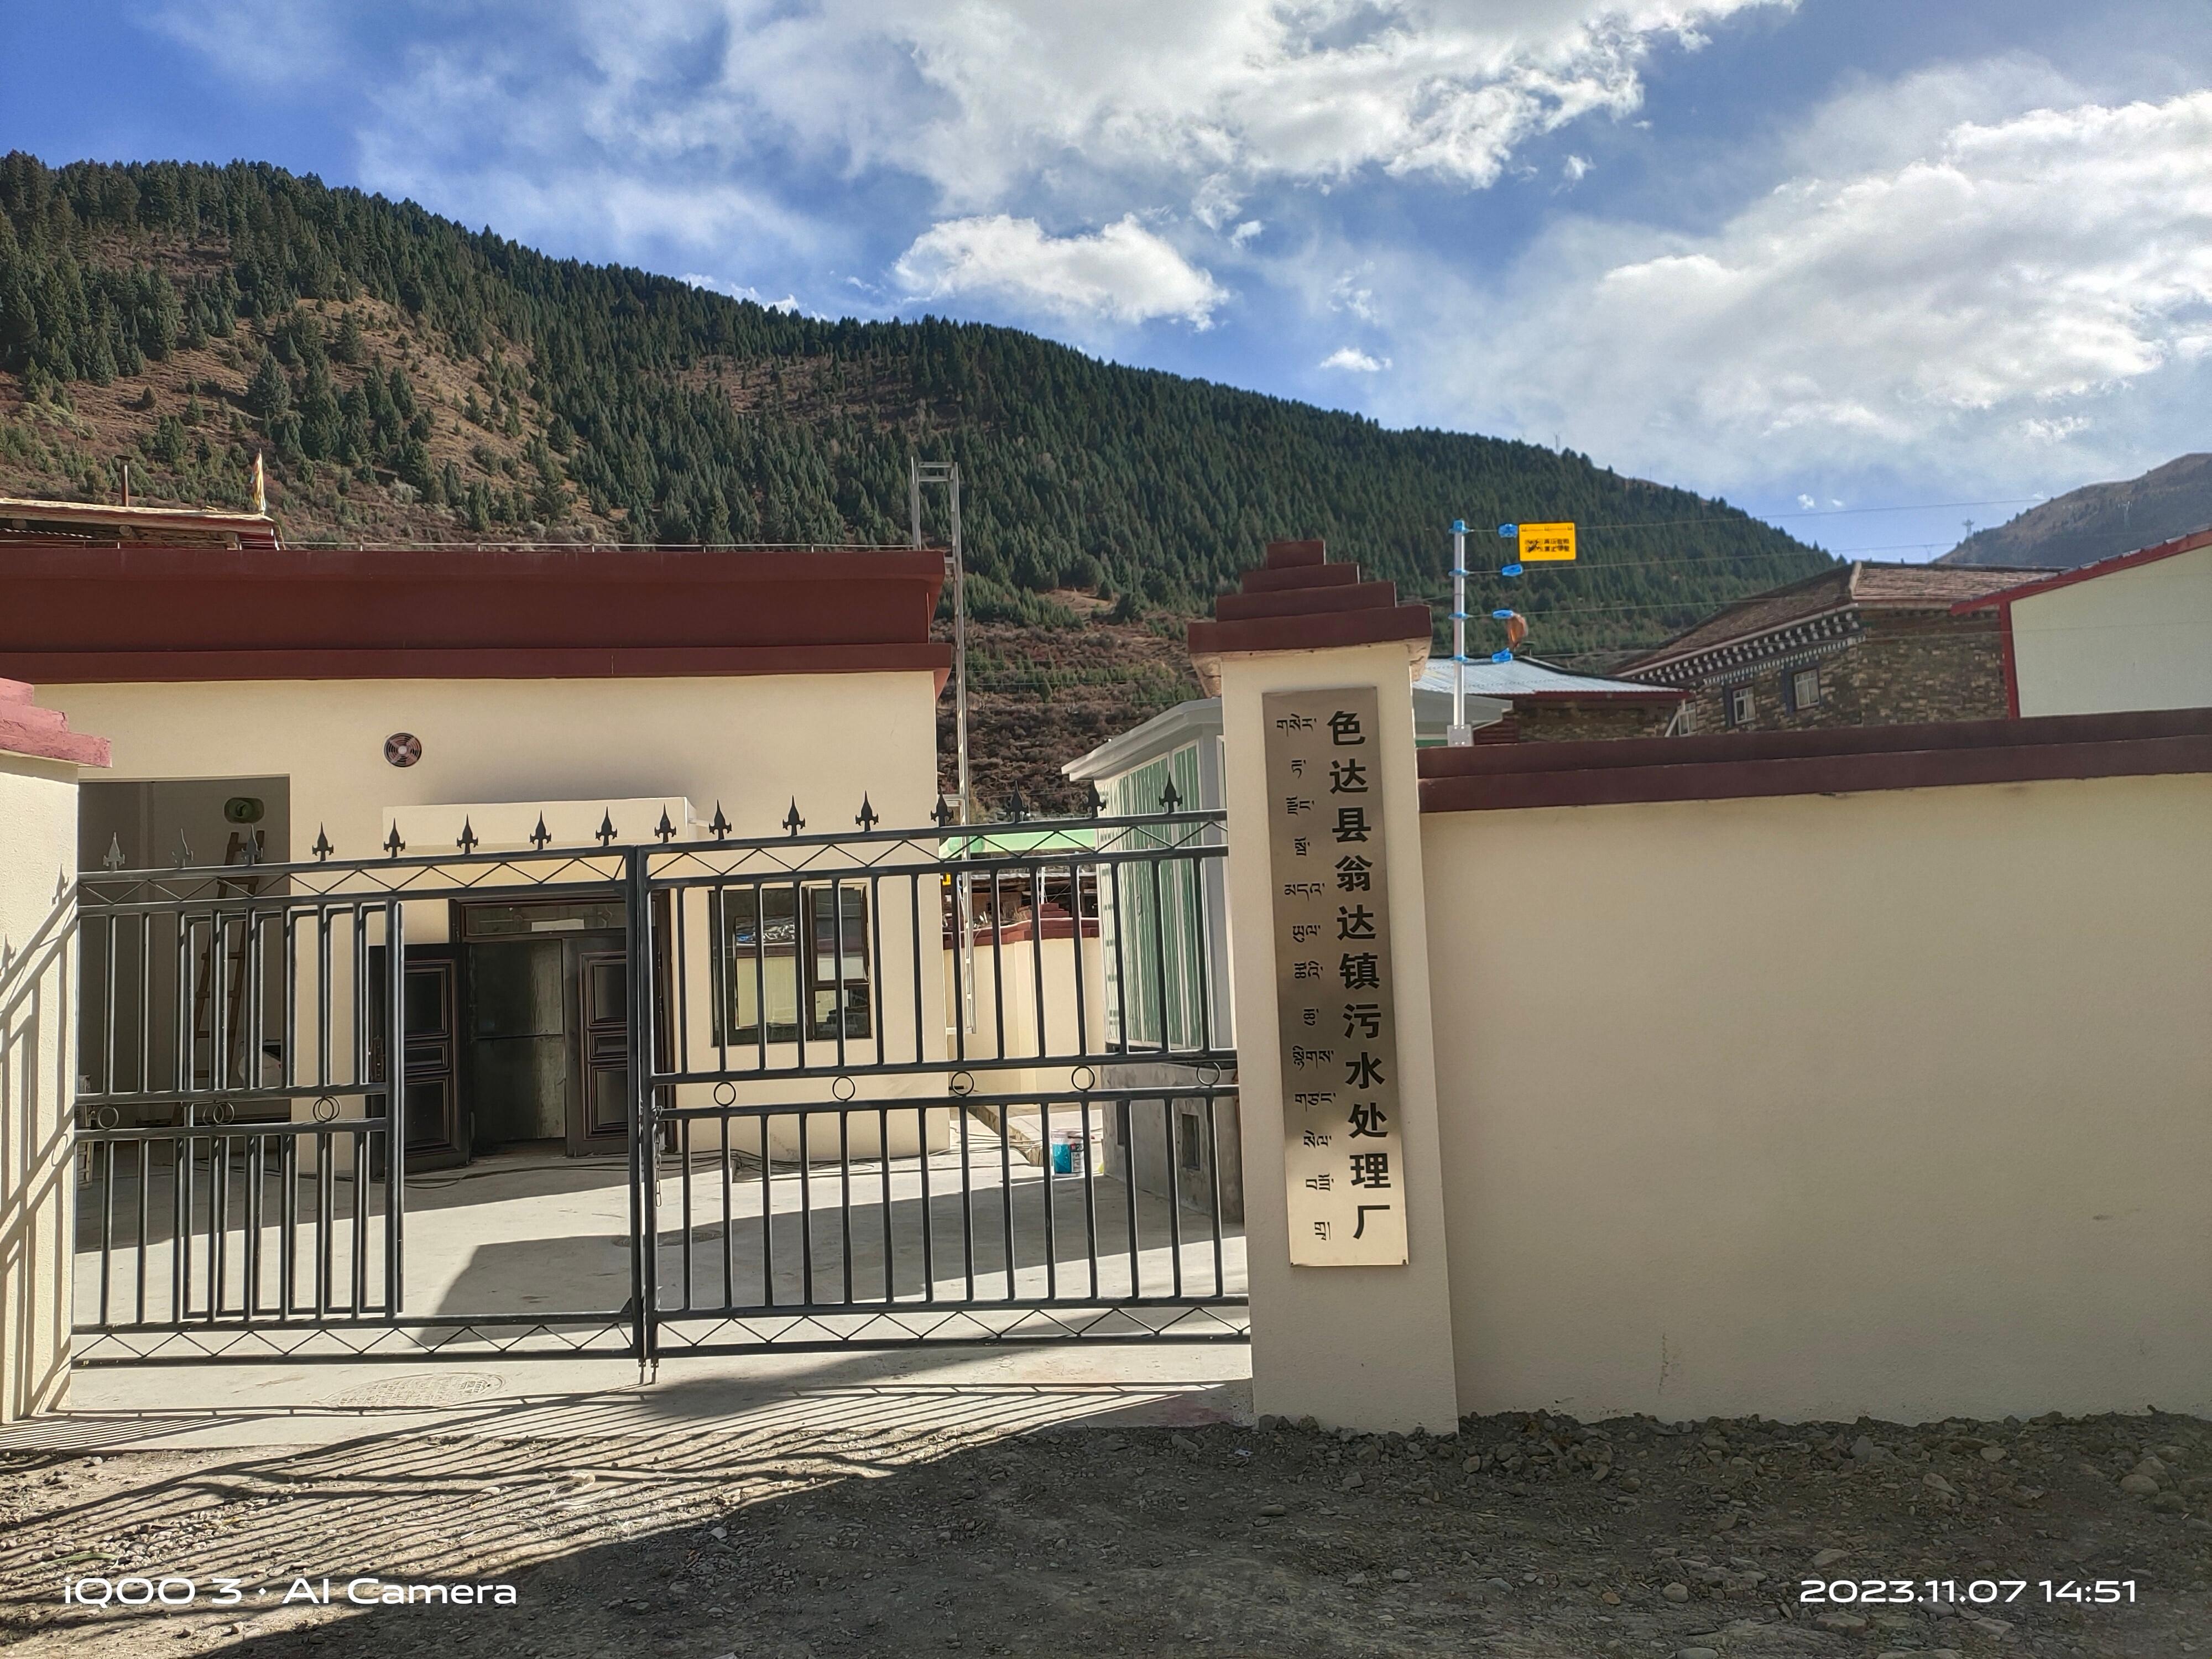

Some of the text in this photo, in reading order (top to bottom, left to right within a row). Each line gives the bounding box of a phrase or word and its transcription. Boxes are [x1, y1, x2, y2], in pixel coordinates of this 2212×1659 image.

[1327, 710, 1391, 1240] 色达县翁达镇污水处理厂
